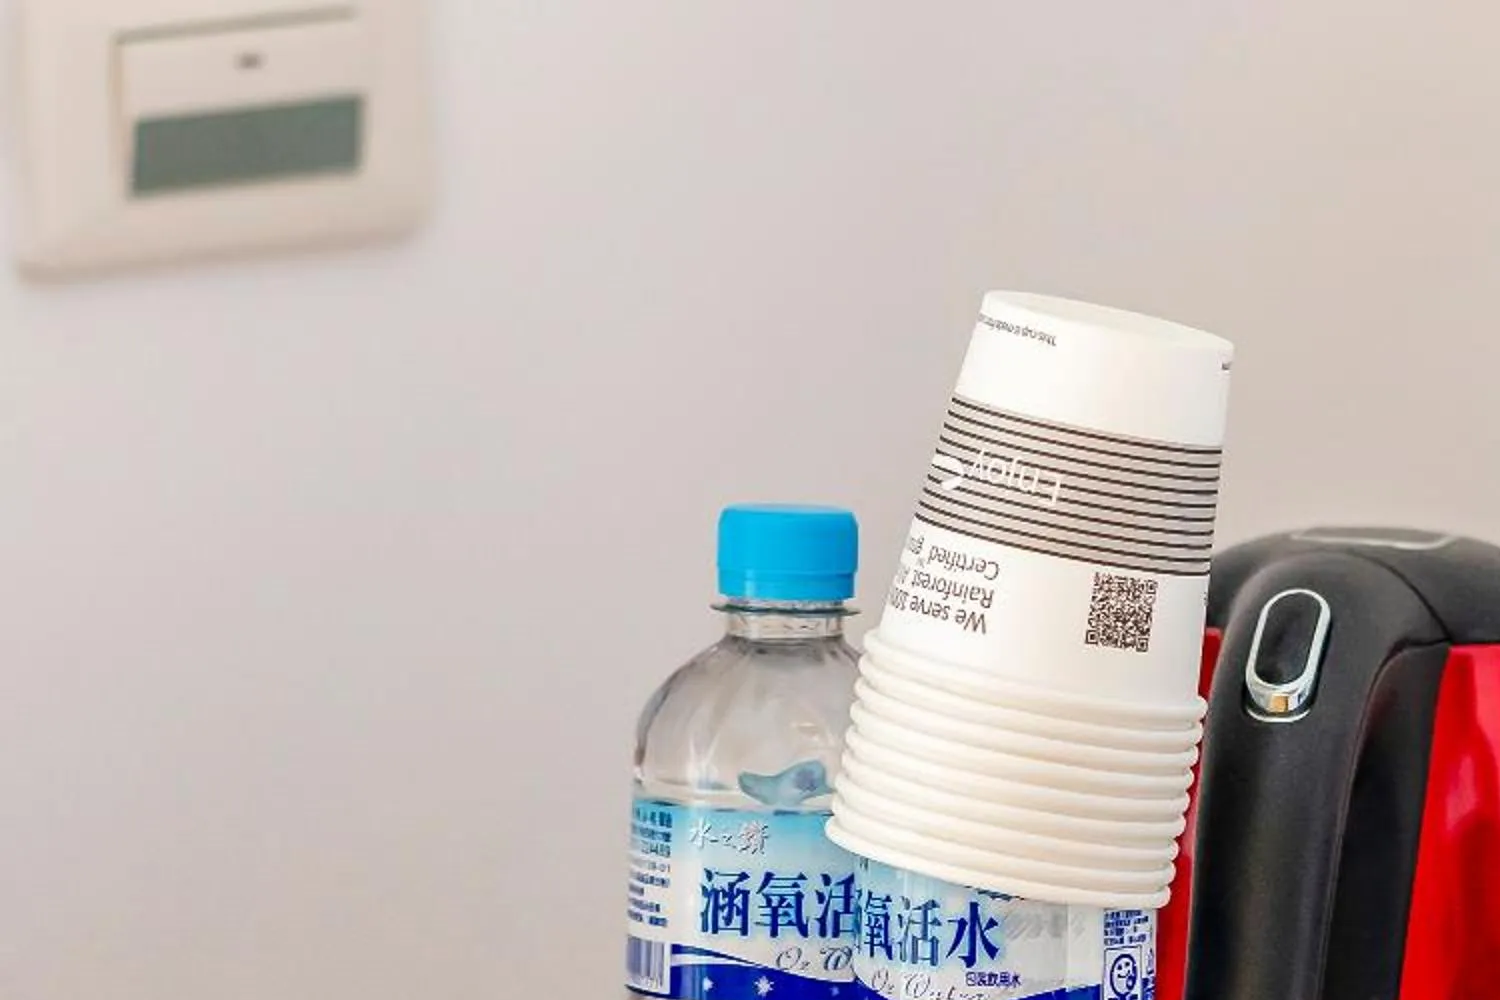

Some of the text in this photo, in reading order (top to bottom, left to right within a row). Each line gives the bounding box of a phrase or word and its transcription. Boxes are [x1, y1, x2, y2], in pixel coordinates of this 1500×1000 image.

[979, 447, 1061, 507] Enjoy
[926, 545, 1000, 581] Certified
[909, 595, 951, 621] serve
[911, 569, 995, 609] Rainforest
[954, 608, 987, 635] We
[856, 888, 1000, 969] 氧活水
